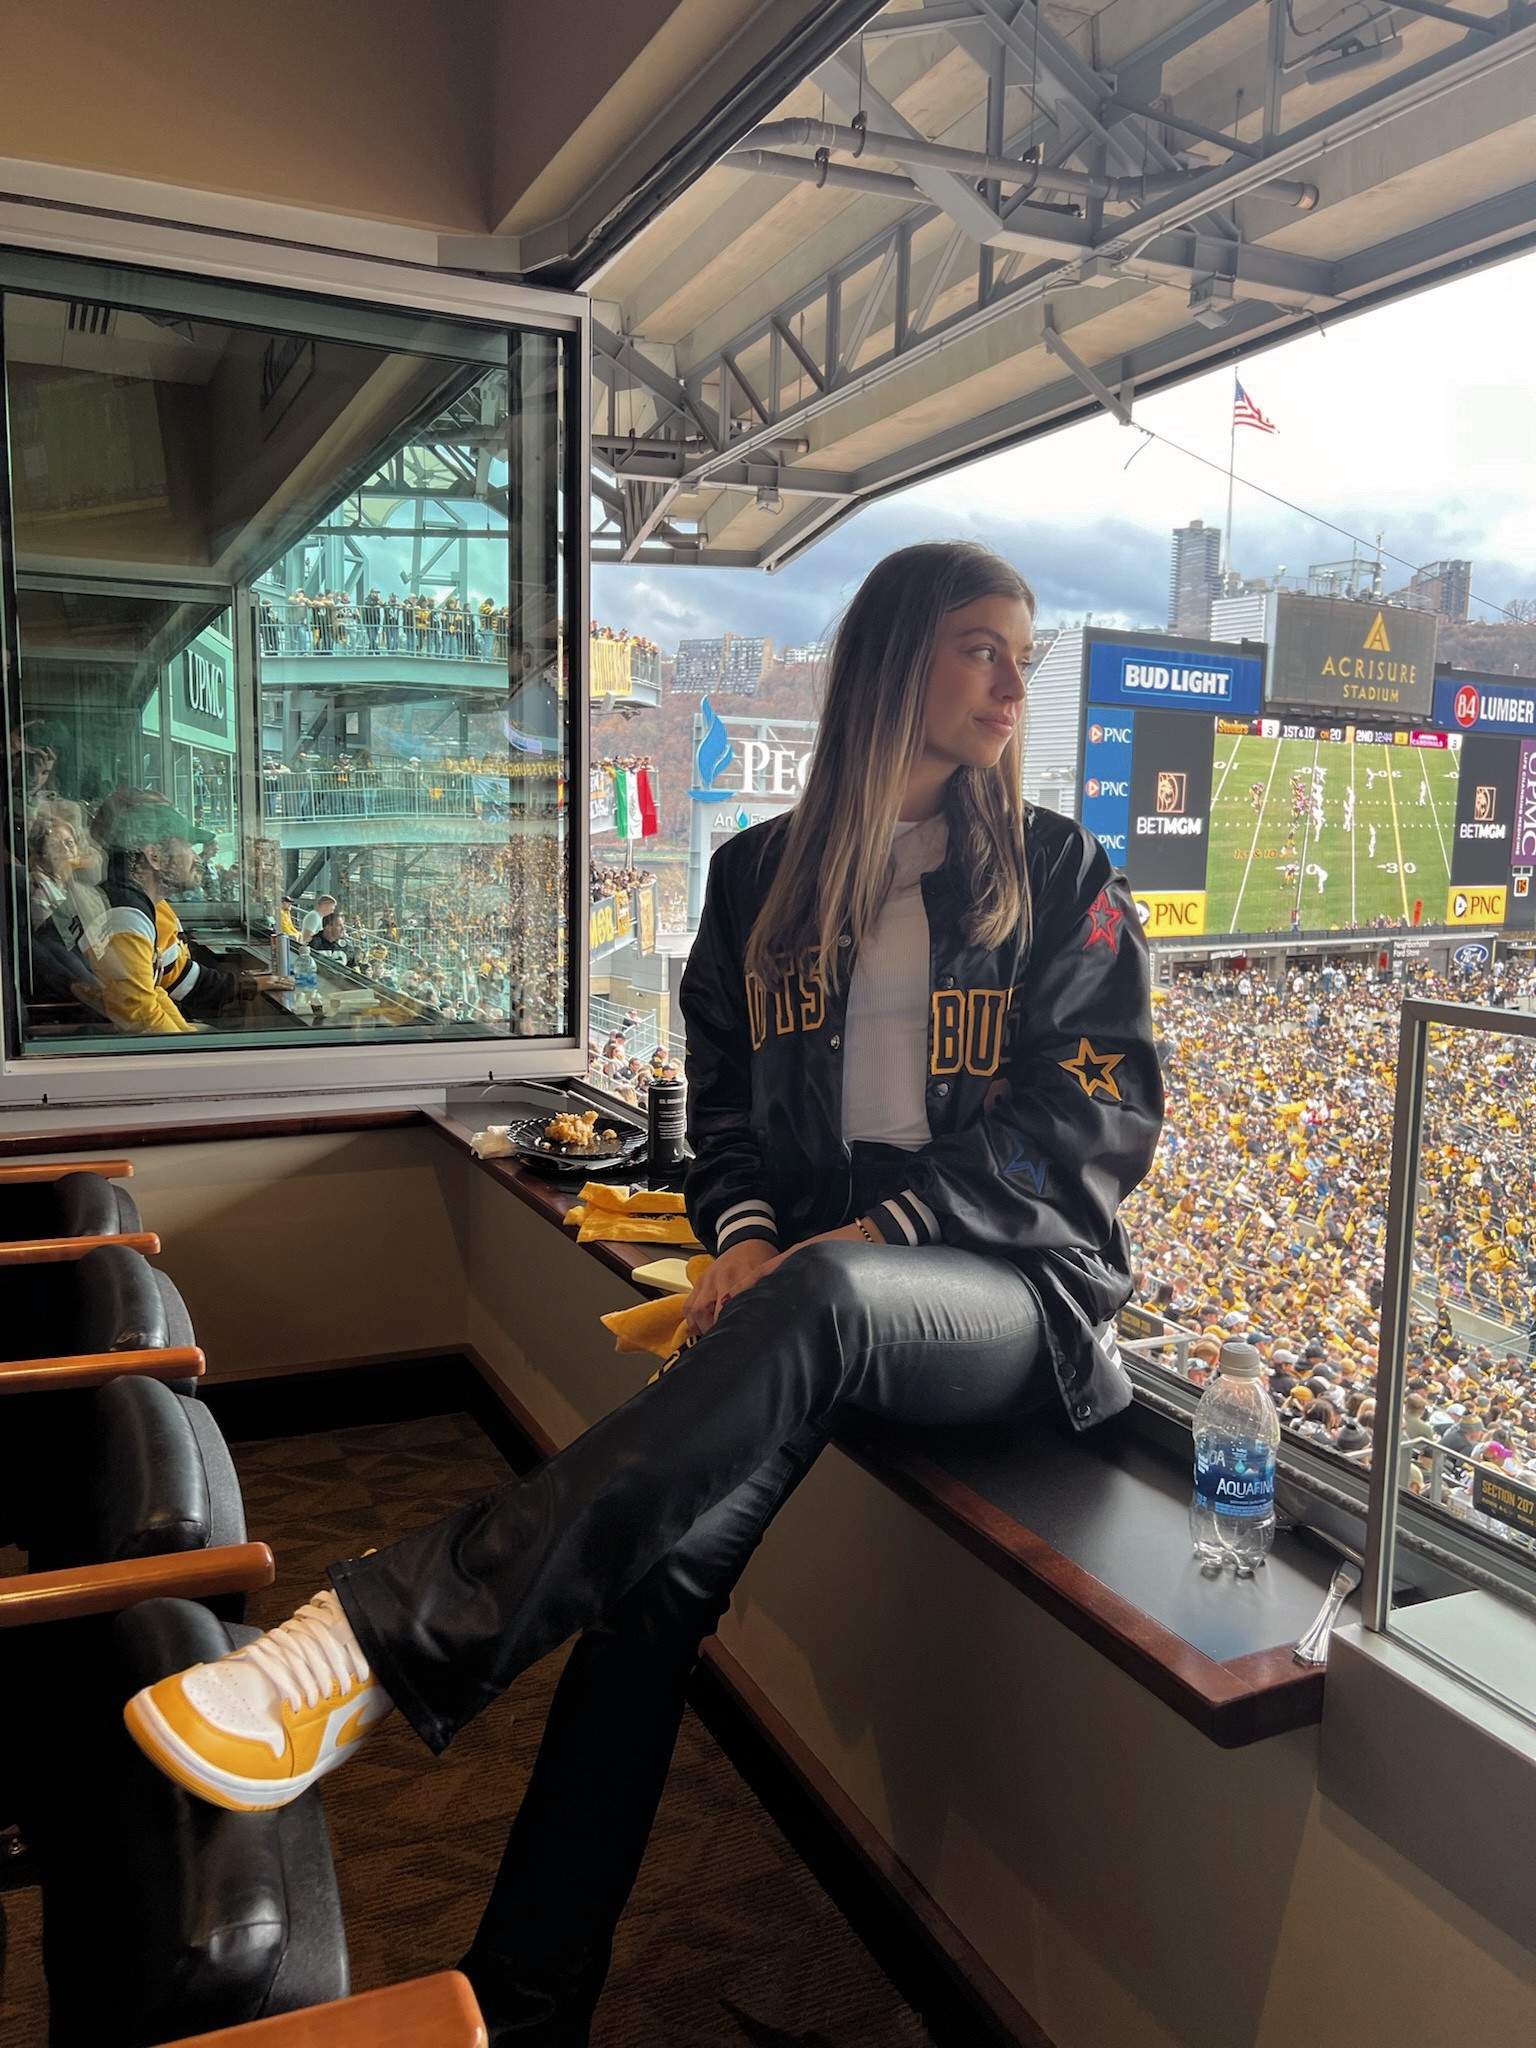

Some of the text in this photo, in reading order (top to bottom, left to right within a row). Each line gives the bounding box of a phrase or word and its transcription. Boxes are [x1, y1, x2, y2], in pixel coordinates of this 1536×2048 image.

[1125, 664, 1229, 695] BUD LIGHT
[1321, 656, 1416, 684] ACRISURE
[187, 649, 224, 720] UPMC
[1343, 684, 1400, 703] STADIUM
[1457, 694, 1535, 724] 84 LUMBER
[1104, 727, 1132, 743] PNC
[1356, 729, 1373, 743] 2ND
[1100, 781, 1129, 797] PNC
[714, 812, 733, 827] An
[1136, 816, 1202, 835] BETMGM
[1460, 823, 1506, 839] BETMGM
[1098, 834, 1126, 850] PNC
[1154, 902, 1198, 926] PNC
[1470, 895, 1501, 915] PNC
[1393, 949, 1420, 957] Ford Store
[1459, 947, 1484, 962] Ford
[1482, 1479, 1516, 1507] SECTION
[1517, 1496, 1534, 1514] 207
